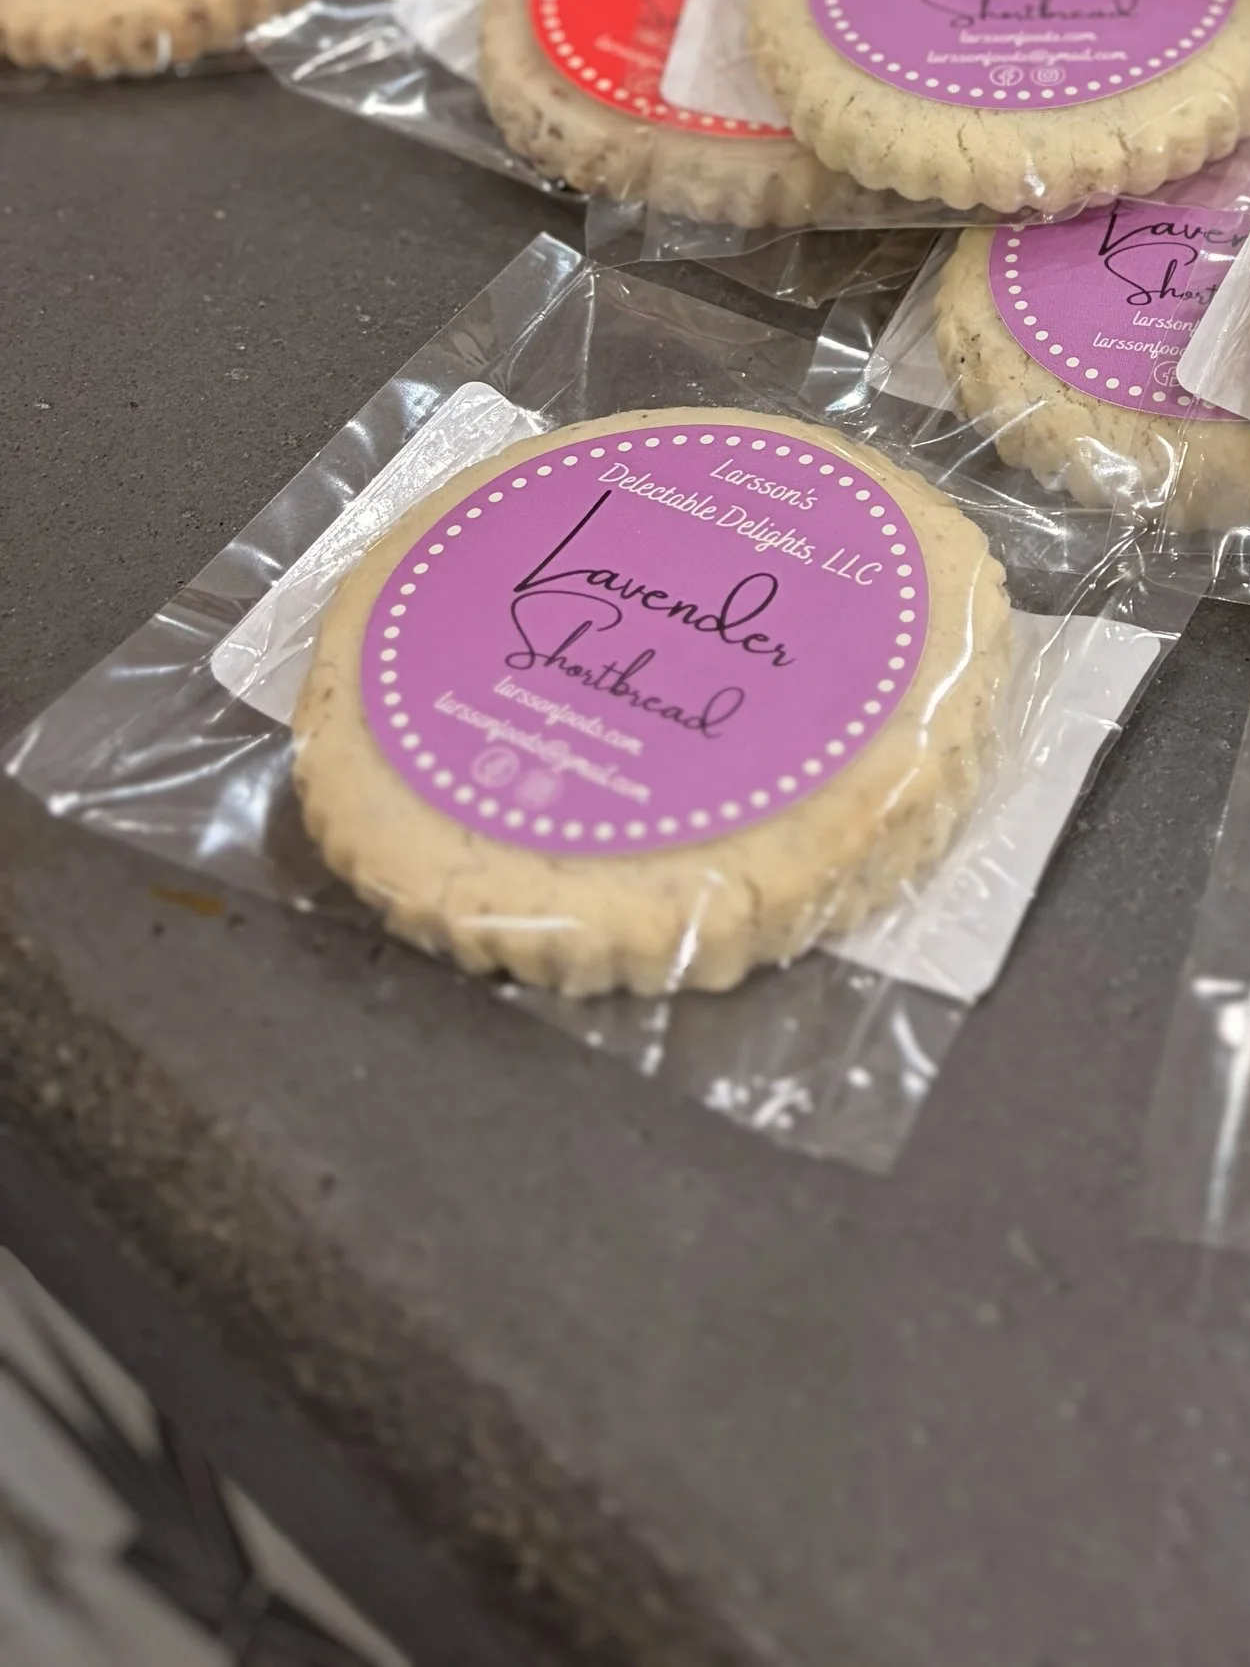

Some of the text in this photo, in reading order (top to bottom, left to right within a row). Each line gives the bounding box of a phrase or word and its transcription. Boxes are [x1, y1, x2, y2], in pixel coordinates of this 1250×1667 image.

[597, 462, 884, 586] Delectable Delights, LLC
[709, 459, 819, 511] Larsson's
[513, 490, 796, 667] Lavender
[505, 590, 746, 739] Shortbread
